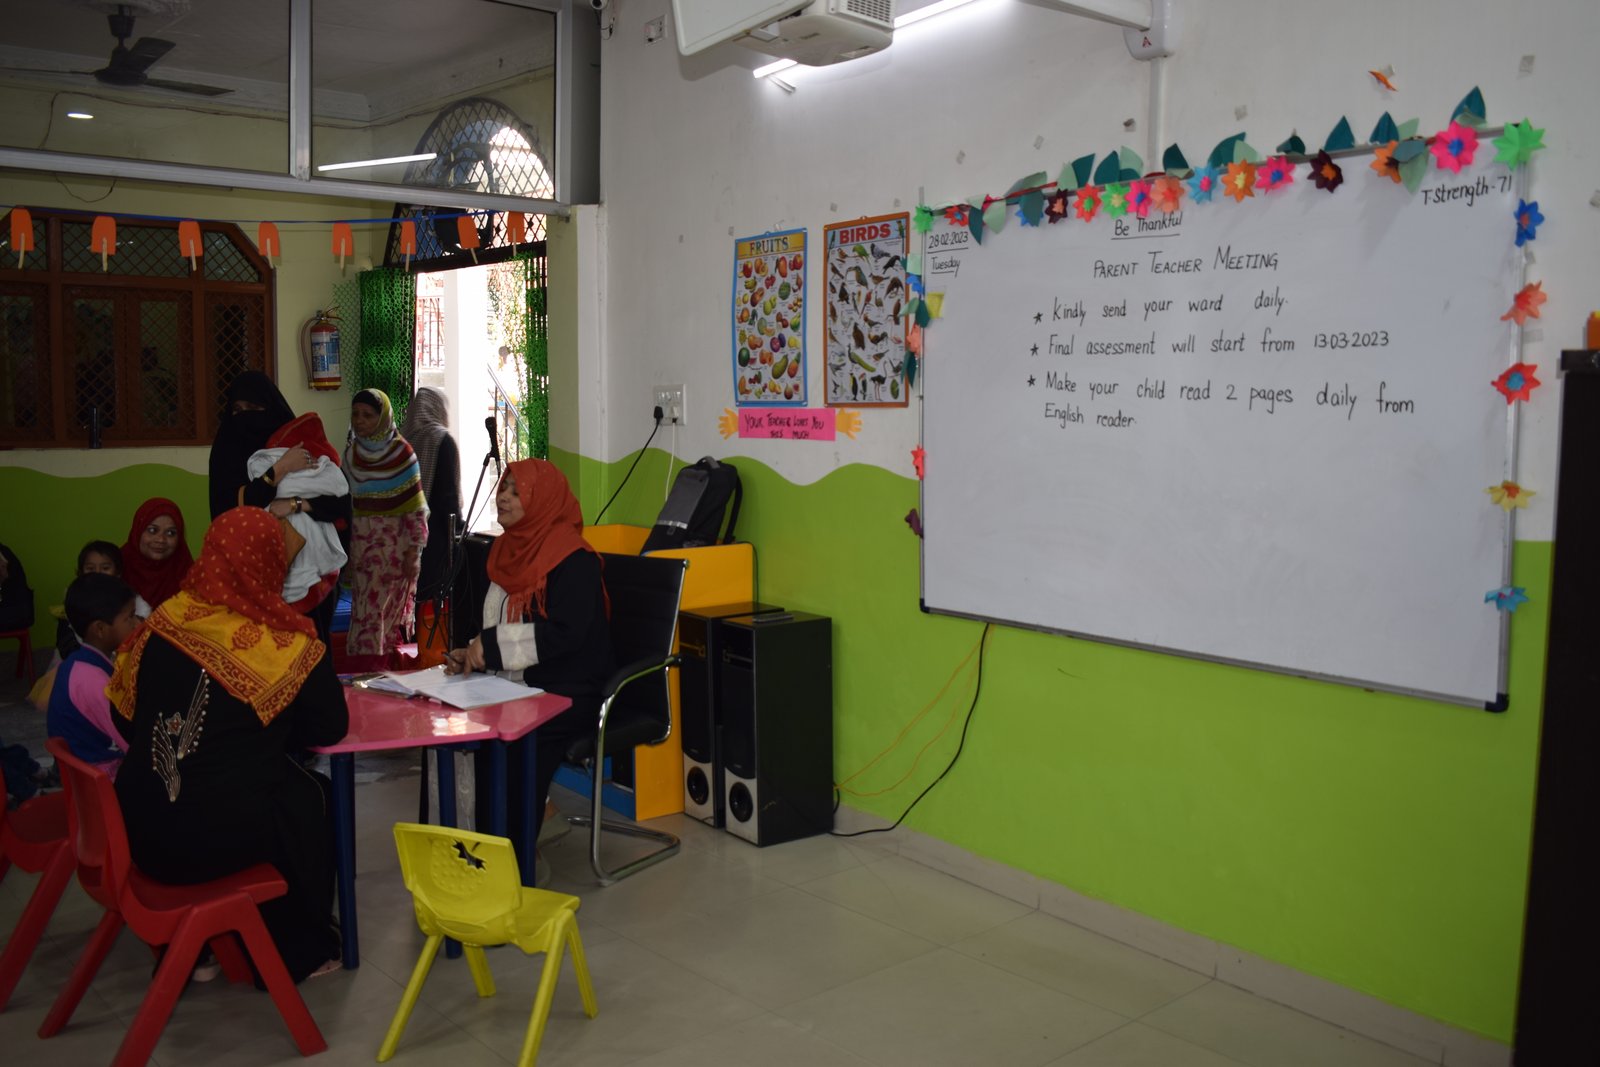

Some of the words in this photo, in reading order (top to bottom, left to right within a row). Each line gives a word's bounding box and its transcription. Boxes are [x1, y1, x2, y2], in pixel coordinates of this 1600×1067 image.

[839, 223, 891, 245] BIRDS
[1114, 219, 1130, 236] Be
[1137, 210, 1183, 233] Thankful
[749, 236, 789, 254] FRUITS
[931, 256, 961, 278] Tuesday
[1093, 260, 1139, 278] PARENT
[1148, 250, 1203, 274] TEACHER
[1213, 245, 1279, 271] MEETING
[1102, 299, 1128, 318] send
[1144, 299, 1174, 322] your
[1188, 294, 1224, 314] ward
[1049, 334, 1075, 356] Final
[1086, 331, 1156, 356] assessment
[1172, 334, 1196, 355] will
[1210, 329, 1246, 353] start
[1260, 327, 1296, 353] from
[1046, 371, 1077, 393] Make
[1089, 381, 1120, 402] your
[1136, 377, 1166, 400] child
[1180, 380, 1211, 401] read
[1226, 384, 1238, 402] 2
[1249, 388, 1294, 414] pages
[1316, 381, 1357, 421] daily
[1375, 380, 1415, 414] from
[811, 415, 825, 430] YOU
[1044, 402, 1085, 430] English
